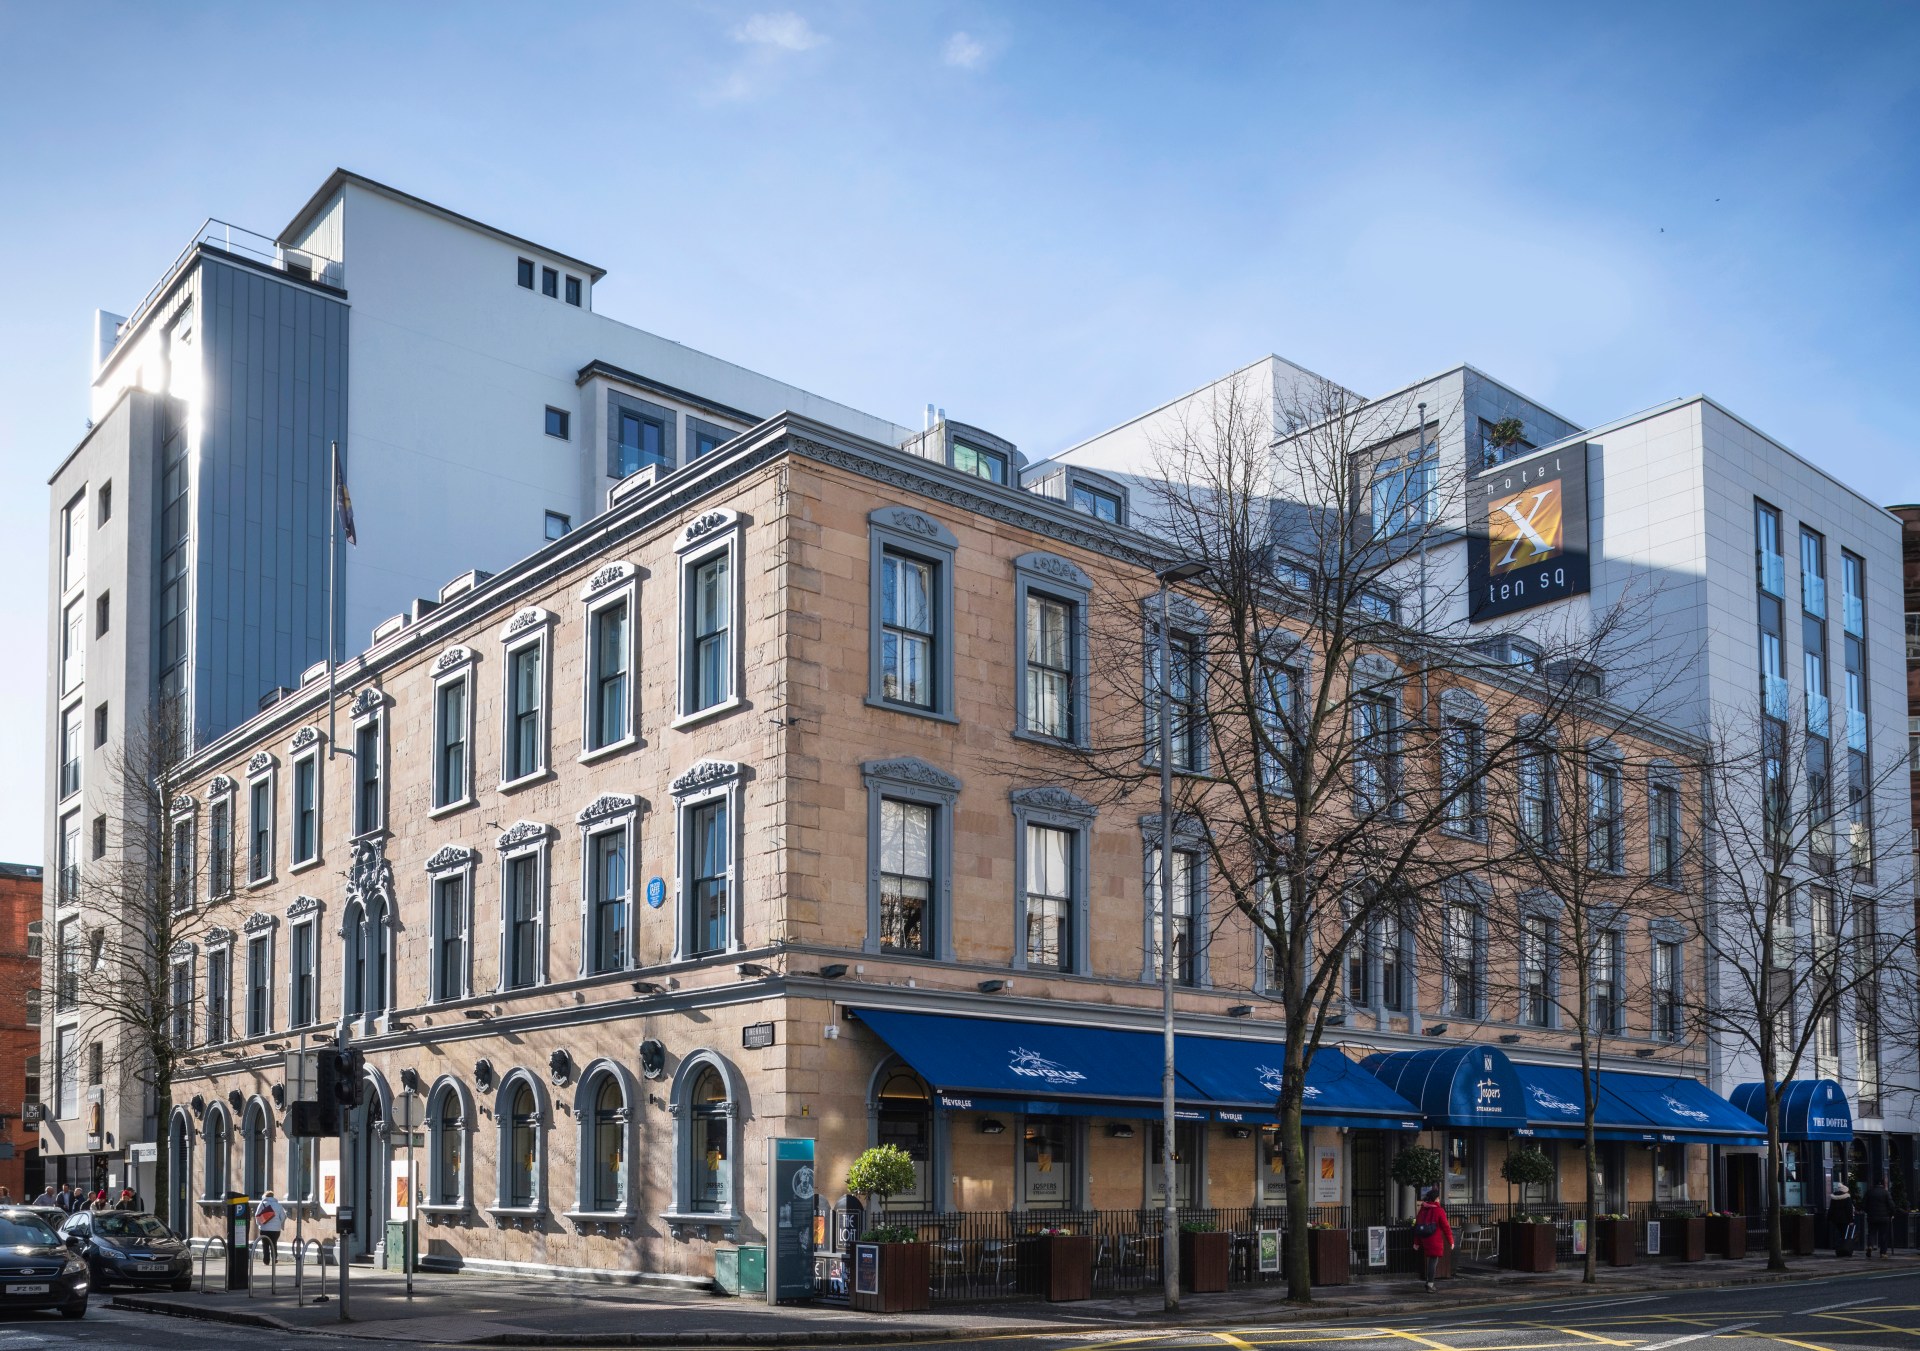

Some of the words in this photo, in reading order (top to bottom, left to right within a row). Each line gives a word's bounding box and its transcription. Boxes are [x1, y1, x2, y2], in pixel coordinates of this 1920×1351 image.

[1487, 458, 1561, 495] hotel
[1496, 489, 1556, 567] X
[1490, 580, 1524, 603] ten
[1540, 568, 1565, 589] sq
[750, 1035, 765, 1044] STREET
[942, 1097, 972, 1110] HEVERLEE
[1812, 1117, 1825, 1126] THE
[1826, 1118, 1848, 1128] DOFFER
[842, 1214, 856, 1228] THE
[839, 1228, 857, 1242] LOFT
